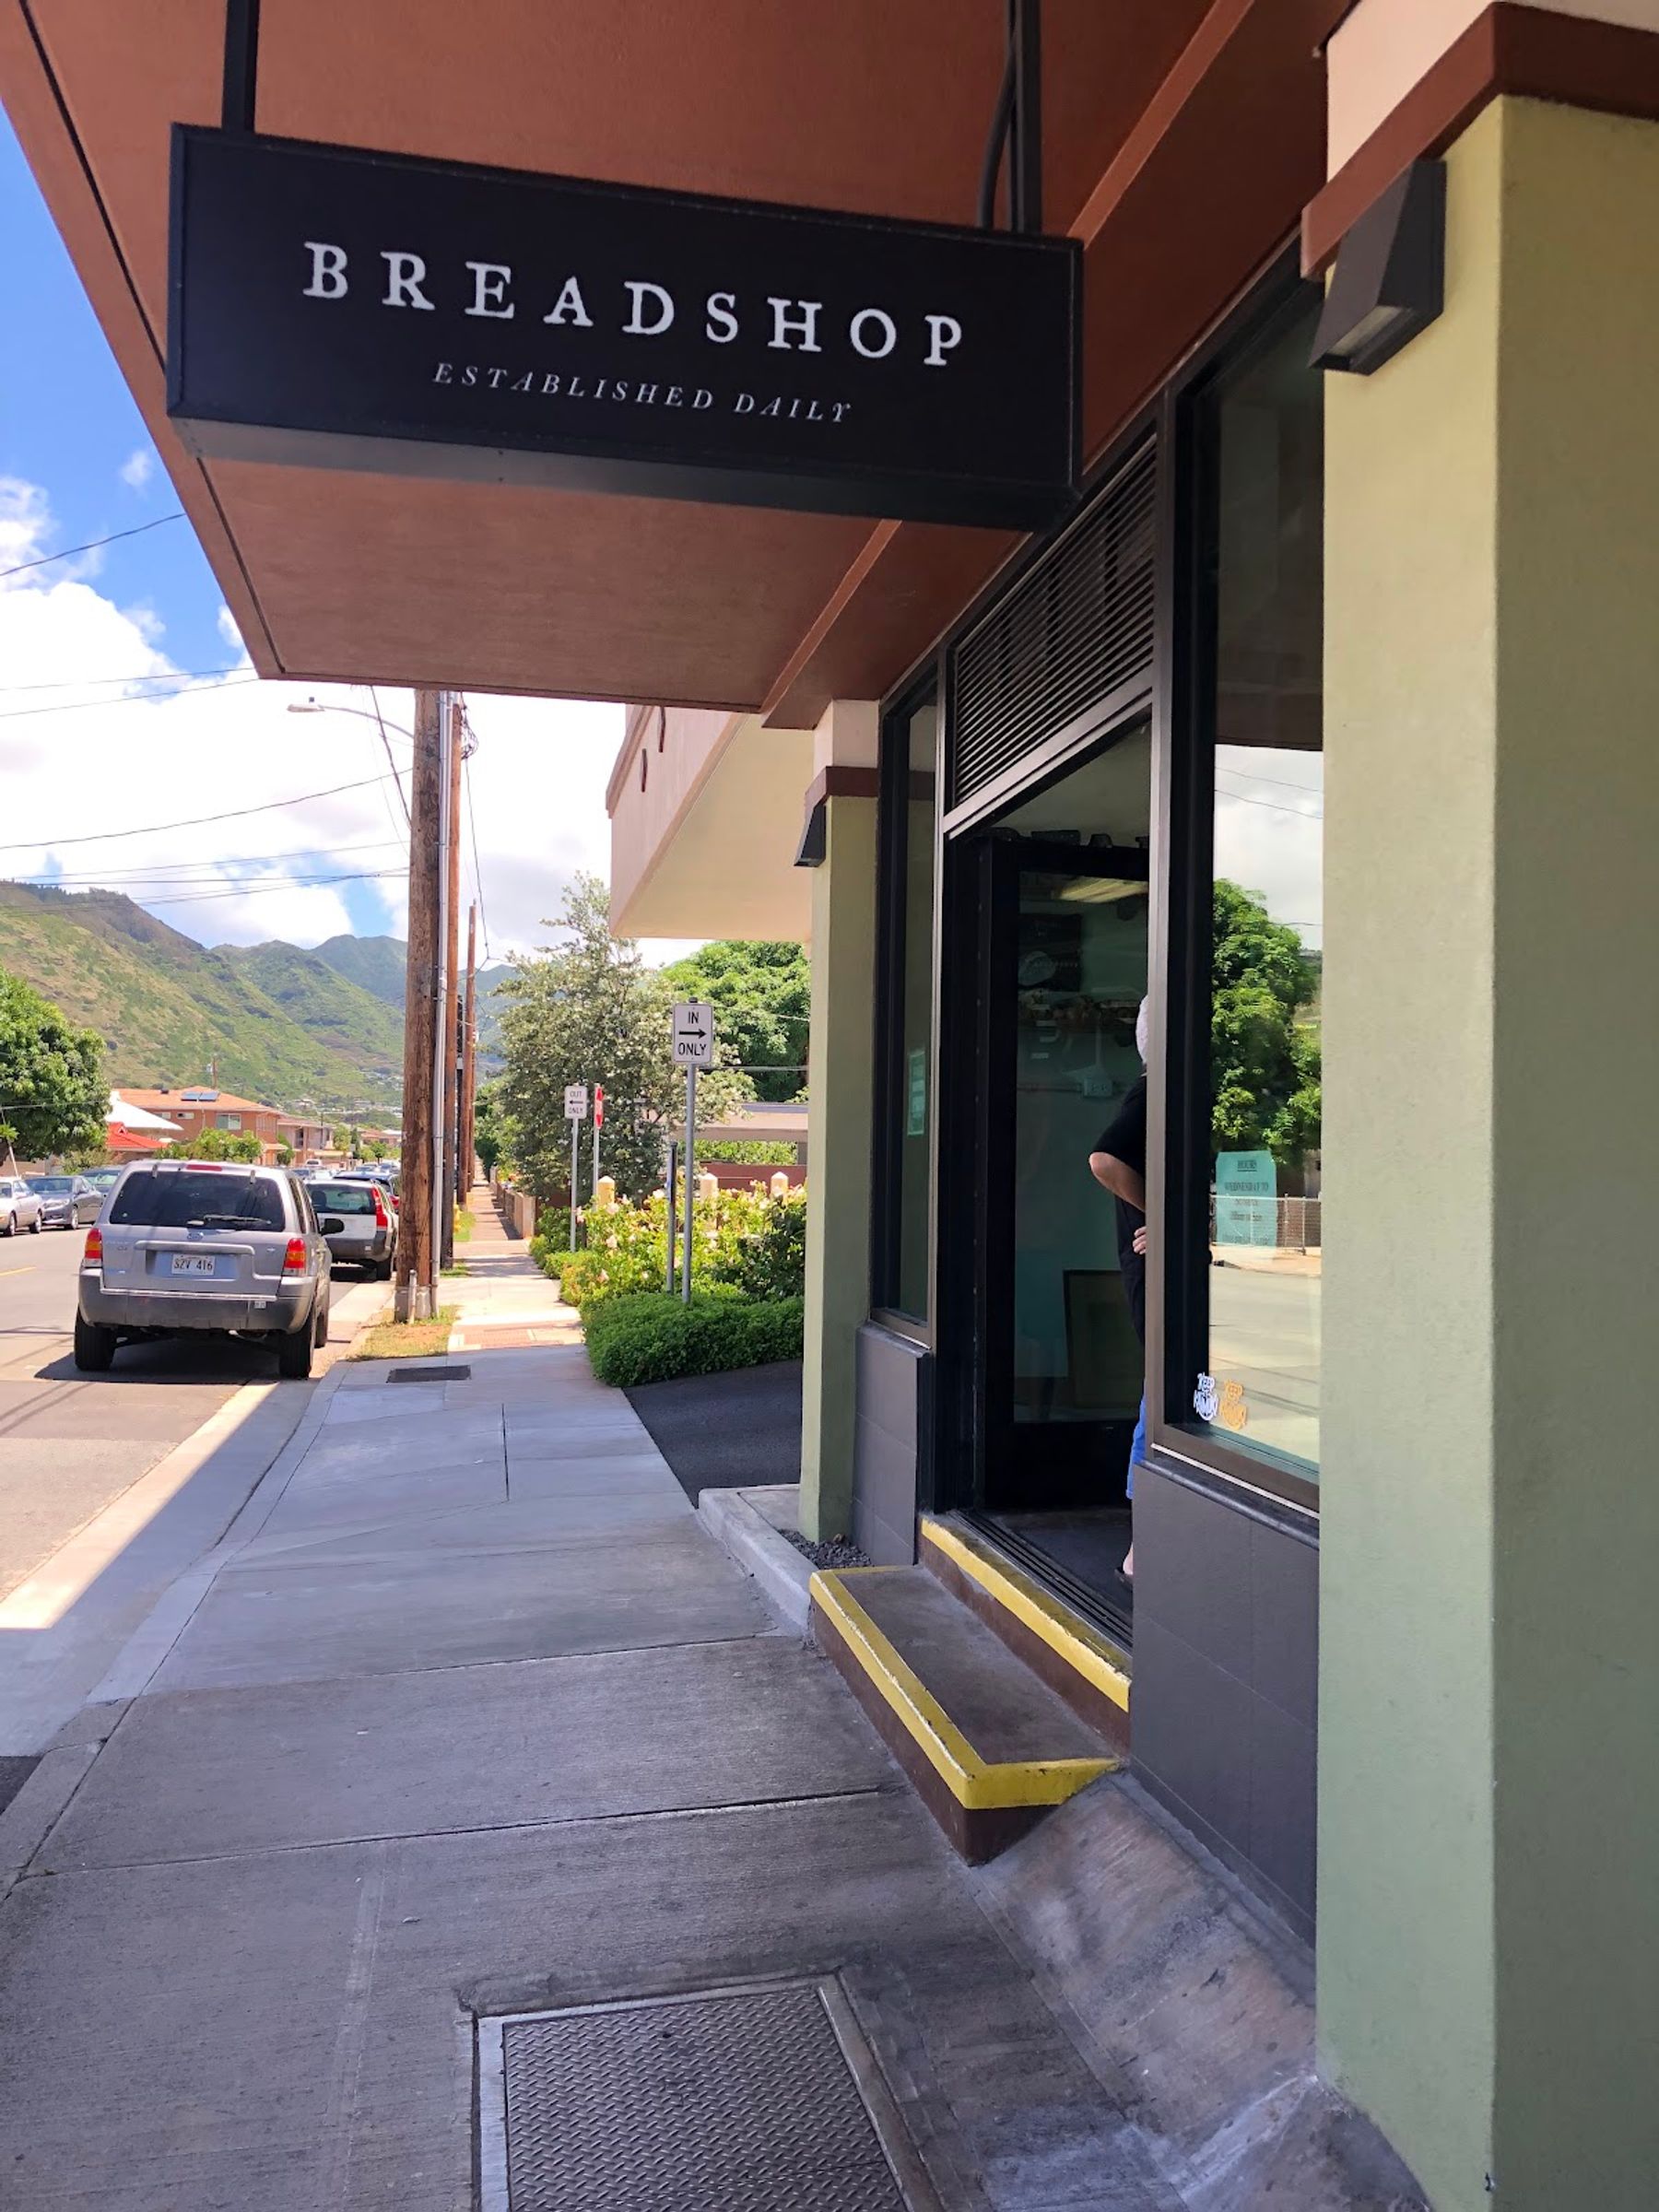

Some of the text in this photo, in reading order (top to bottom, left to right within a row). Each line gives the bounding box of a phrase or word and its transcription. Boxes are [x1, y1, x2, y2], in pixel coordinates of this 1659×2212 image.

[302, 241, 962, 367] BREADSHOP
[432, 362, 852, 422] ESTABLISHED DAILY
[688, 1011, 700, 1024] IN
[677, 1042, 707, 1056] ONLY
[569, 1090, 582, 1099] OUT
[195, 1259, 214, 1271] 416
